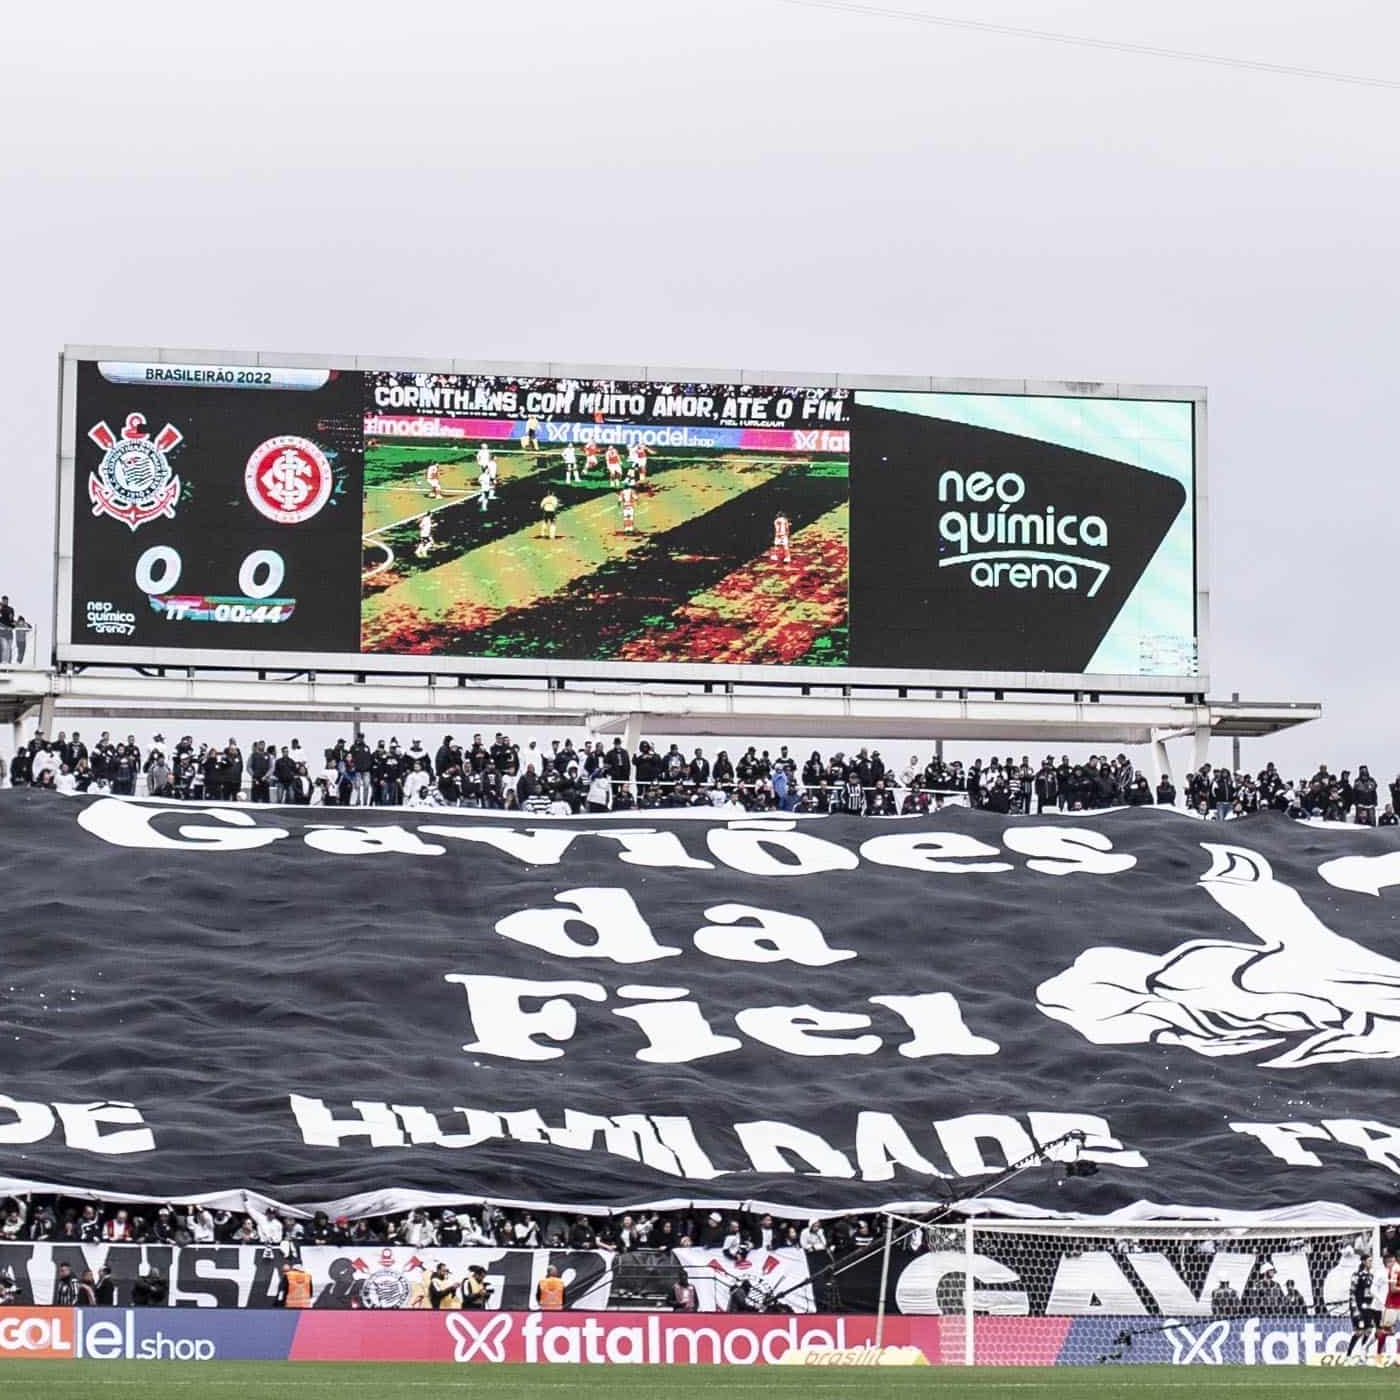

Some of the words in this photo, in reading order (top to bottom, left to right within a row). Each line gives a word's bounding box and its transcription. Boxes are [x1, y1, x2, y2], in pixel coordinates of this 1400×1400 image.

[145, 367, 234, 384] BRASILEIRÃO
[237, 371, 272, 384] 2022
[775, 398, 793, 419] O
[938, 470, 1026, 503] neo
[938, 503, 1109, 554] química
[135, 545, 182, 596] 0
[238, 549, 286, 600] 0
[214, 604, 283, 623] 00:44
[495, 887, 858, 967] da
[444, 973, 1000, 1064] Fiel
